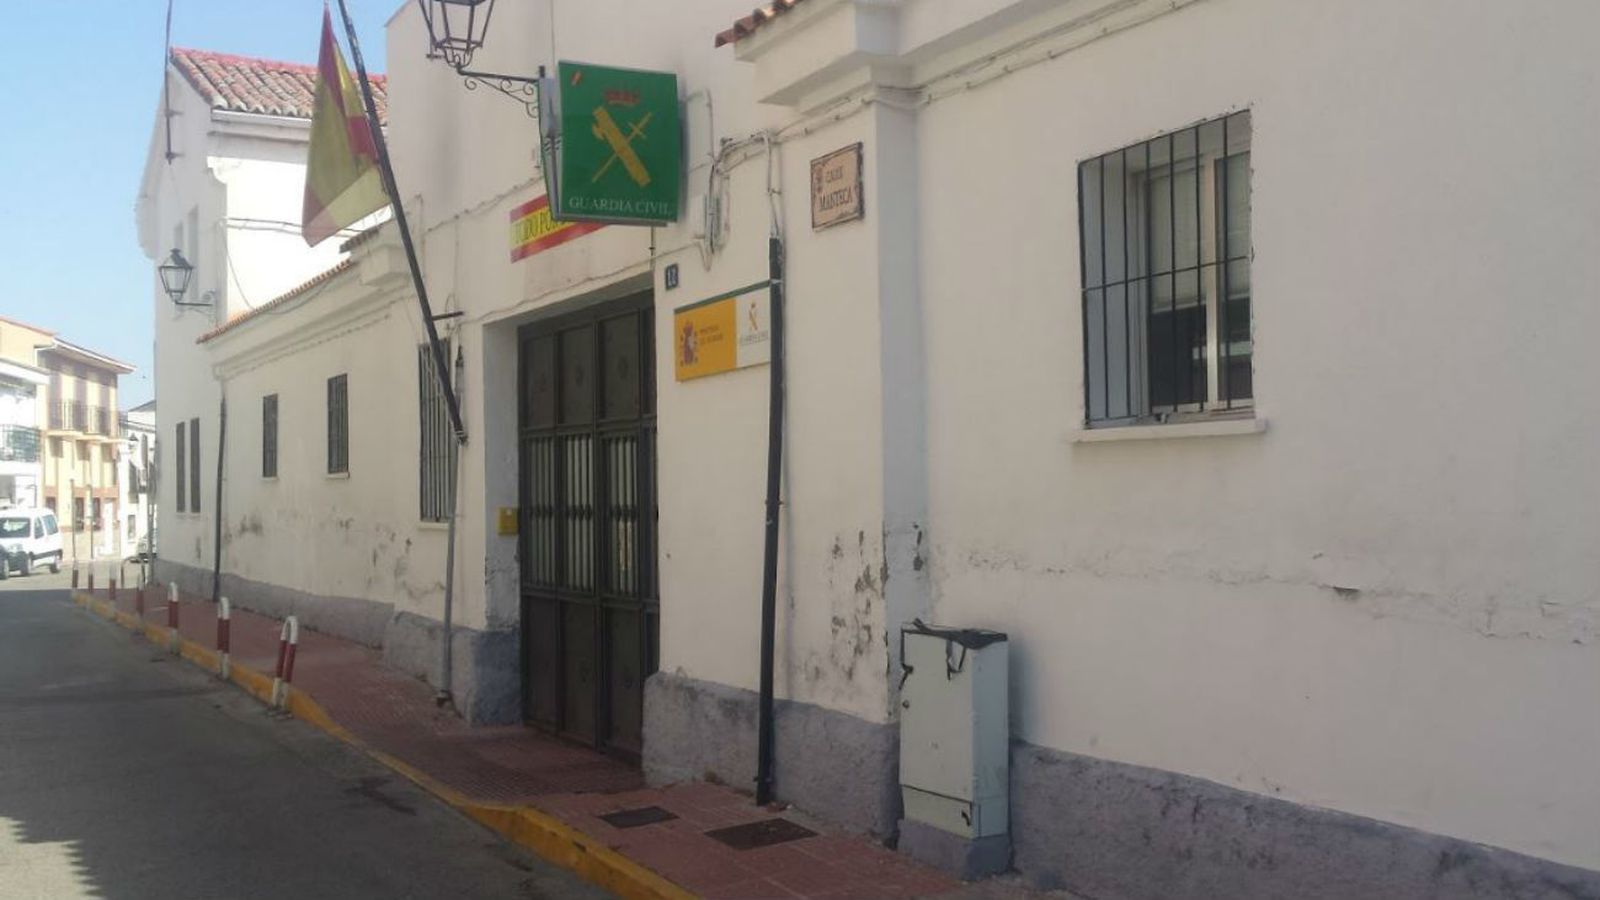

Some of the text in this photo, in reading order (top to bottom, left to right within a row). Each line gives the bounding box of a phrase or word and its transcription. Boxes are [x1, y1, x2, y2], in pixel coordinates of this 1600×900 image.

[568, 196, 673, 215] GUARDIA CIVIL
[819, 186, 853, 211] MANTECA
